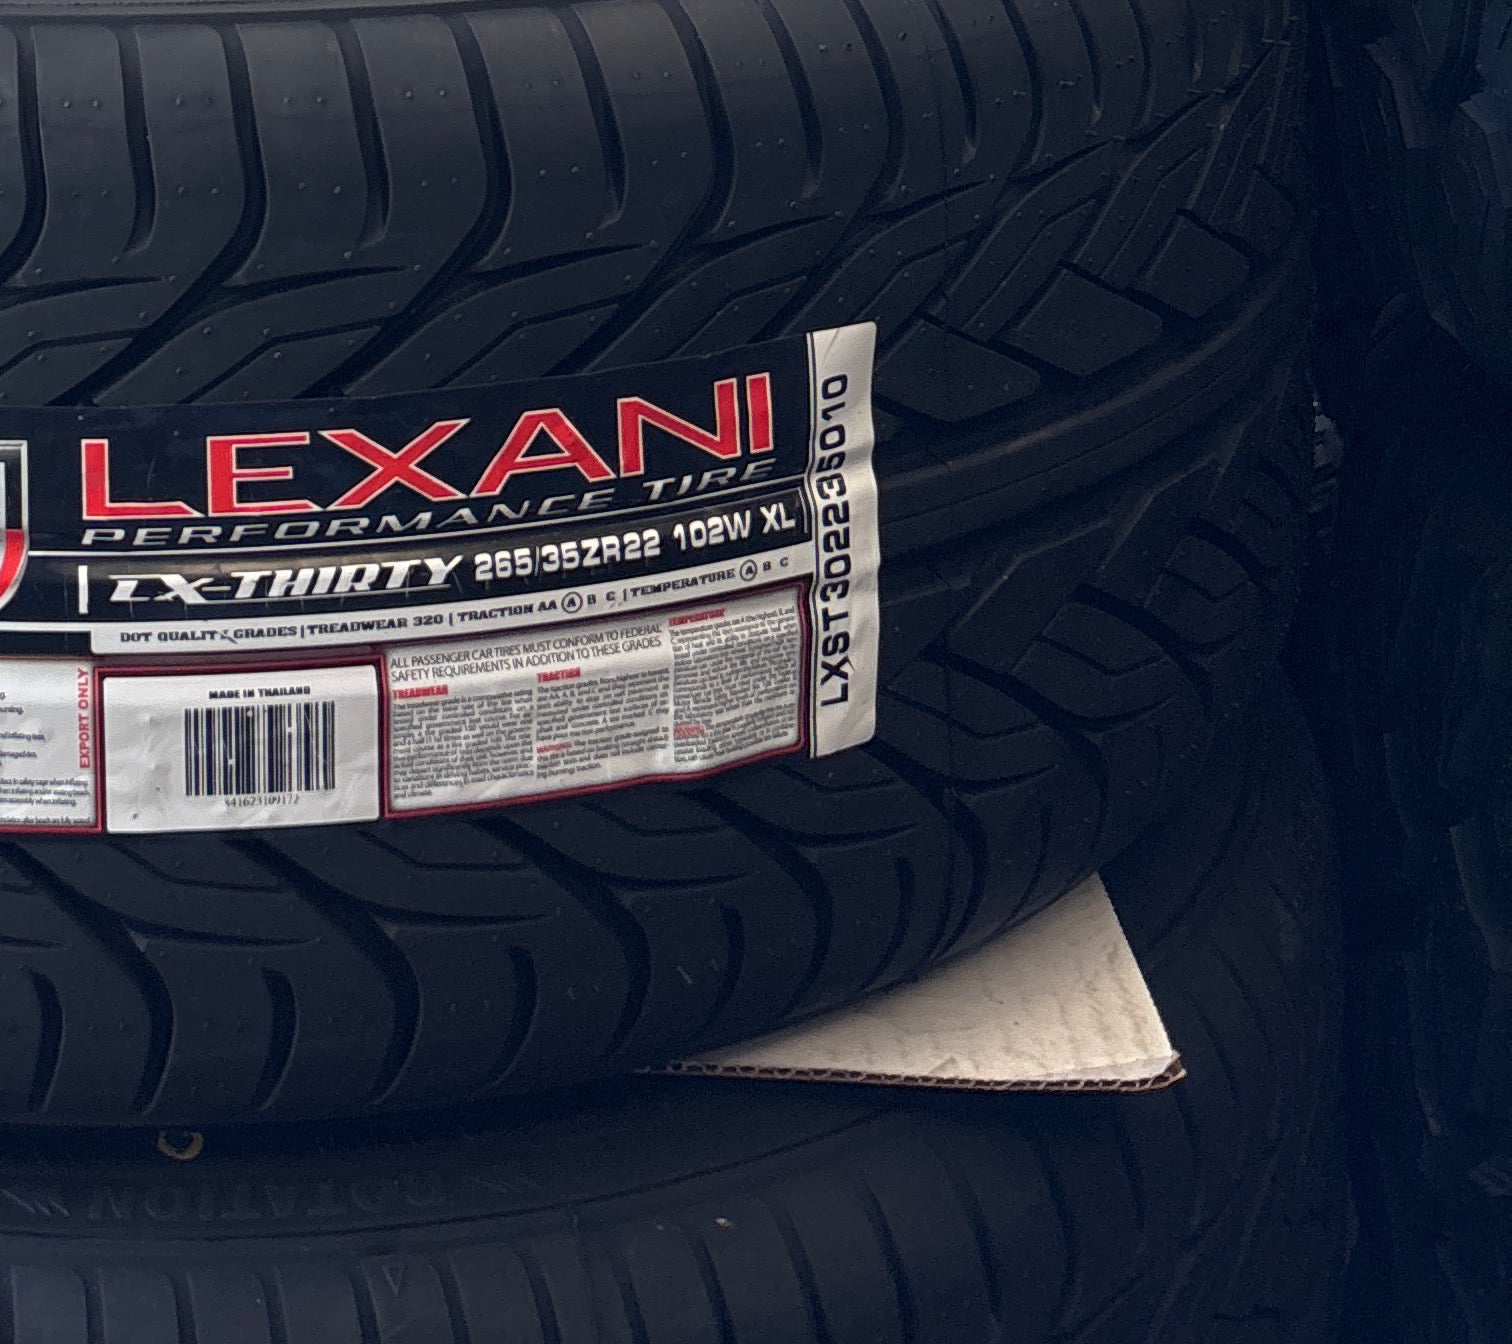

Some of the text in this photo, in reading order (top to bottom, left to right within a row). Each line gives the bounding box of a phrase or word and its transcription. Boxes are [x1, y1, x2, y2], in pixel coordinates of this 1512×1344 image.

[81, 373, 774, 521] LEXANI
[81, 457, 777, 547] PERFORMANCE TIRE
[819, 374, 852, 707] LXST302235010
[108, 501, 796, 605] LX-THIRTY 265/35ZR22 102W XL
[120, 632, 152, 643] DOT
[233, 626, 297, 639] GRADES
[309, 617, 407, 635] TREADWEAR
[413, 614, 444, 627] 320
[457, 603, 534, 622] TRACTION
[537, 599, 558, 612] AA
[587, 594, 596, 605] B
[605, 591, 616, 602] C
[629, 568, 736, 598] TEMPERATURE
[762, 561, 772, 572] B
[779, 556, 790, 568] C
[390, 623, 662, 669] ALL PASSENGER CAR TIRES MUST CONFORM TO FEDERAL
[391, 636, 662, 682] SAFETY REQUIREMENTS IN ADDITION TO THESE GRADES
[77, 668, 91, 769] EXPORT ONLY
[208, 685, 311, 699] MADE IN THAILAND
